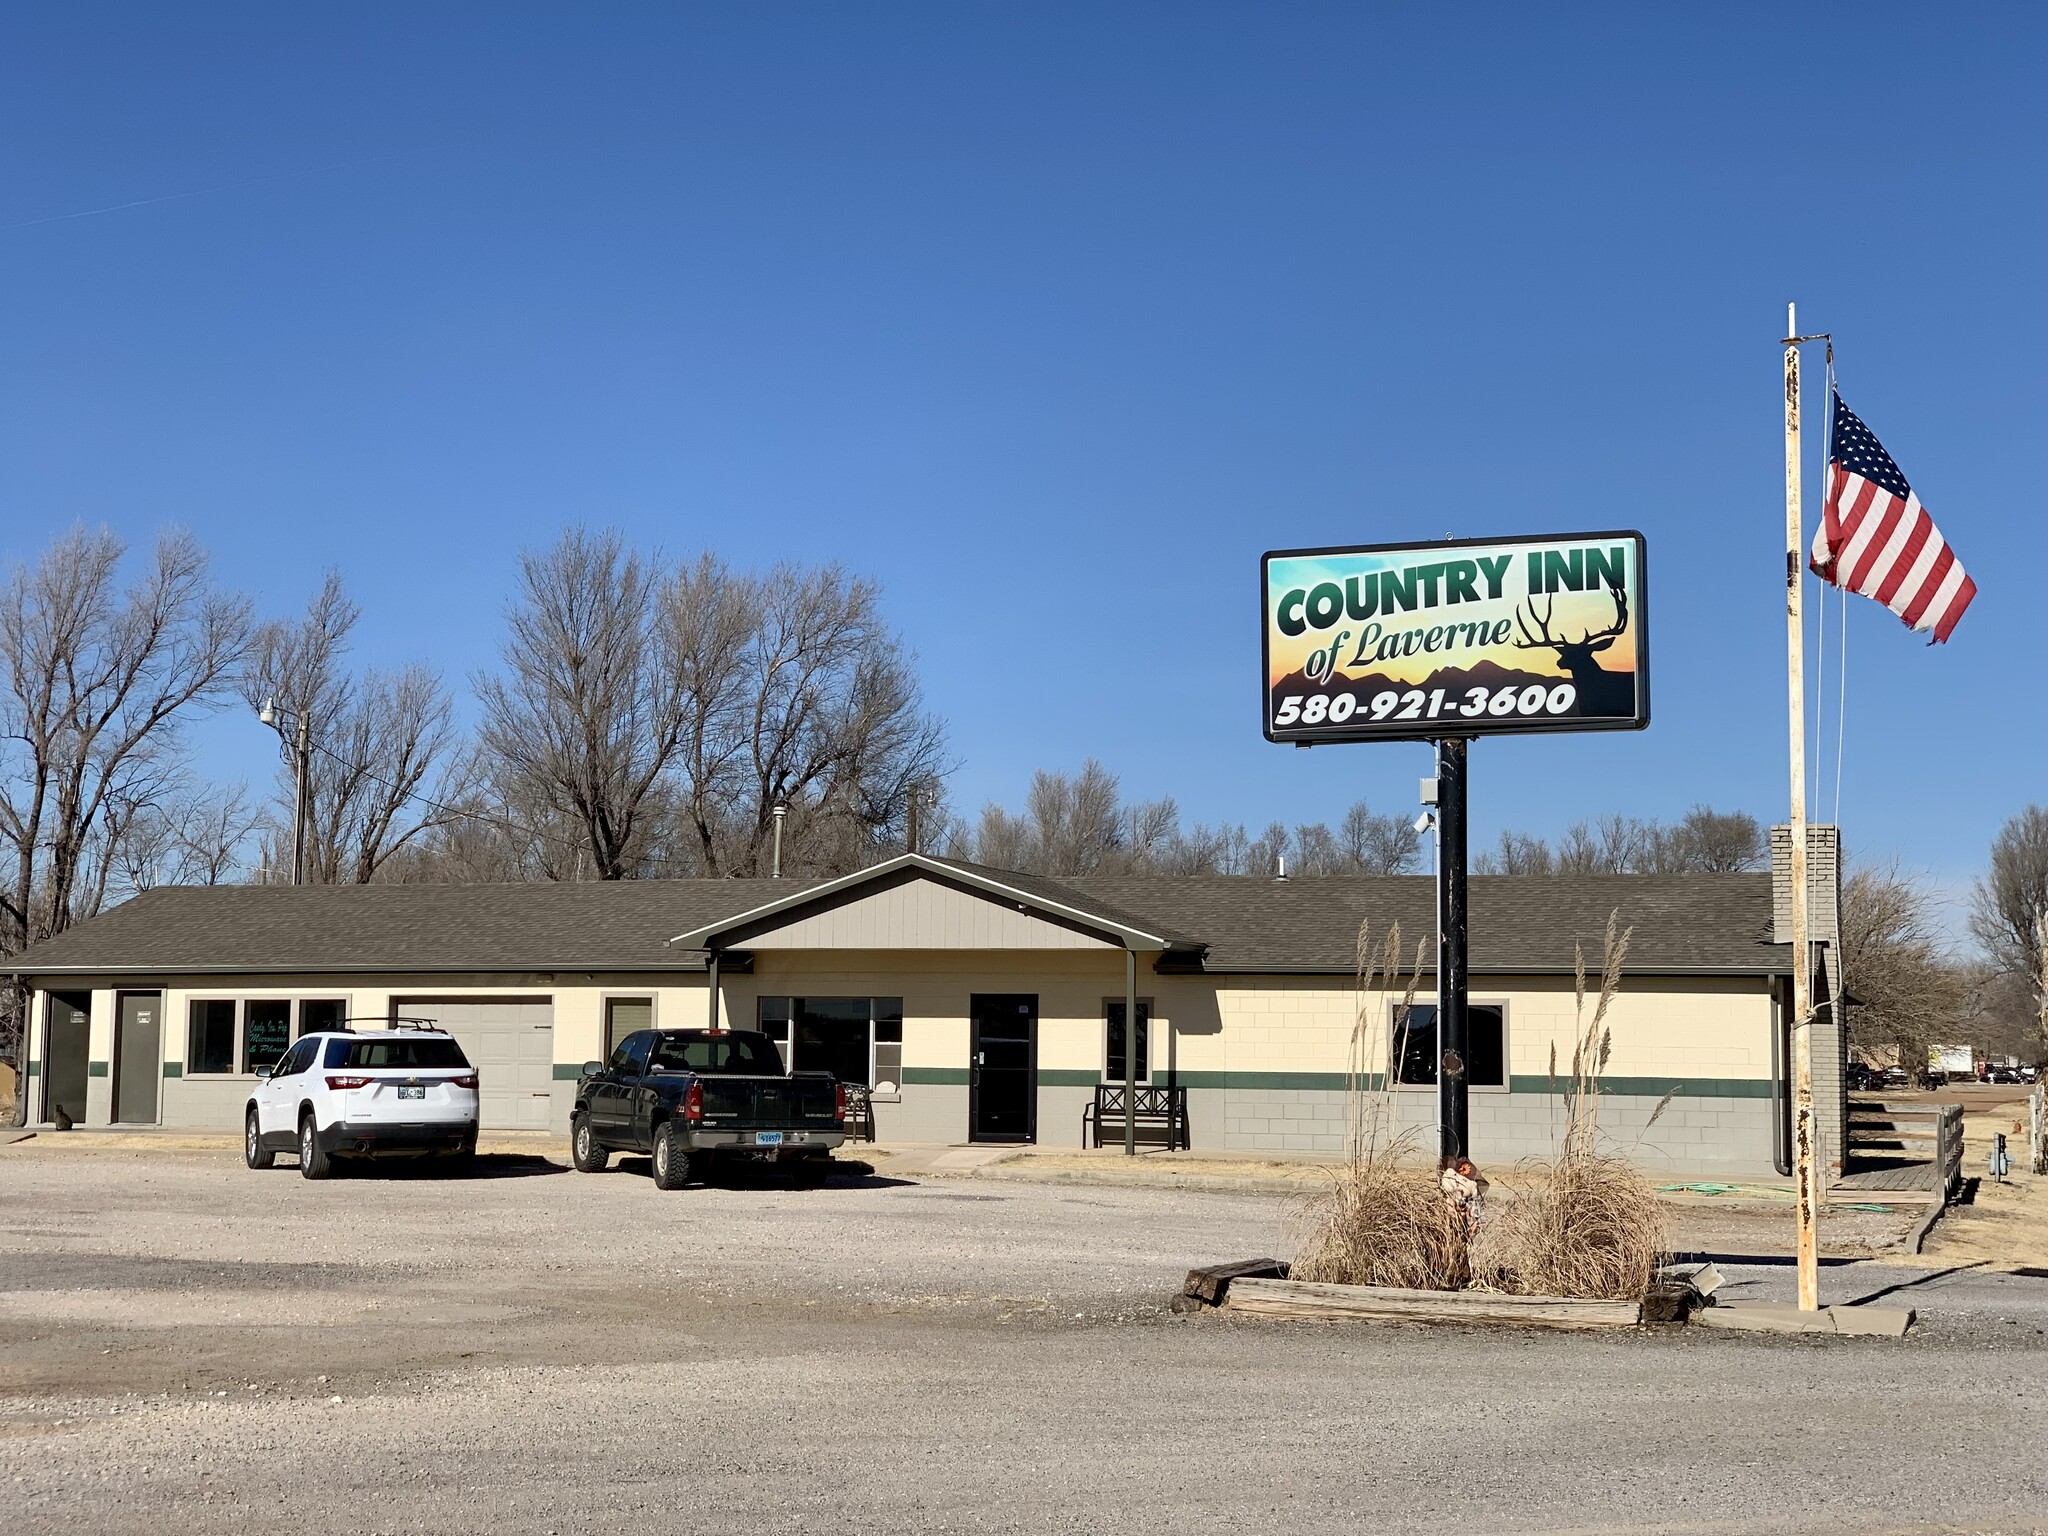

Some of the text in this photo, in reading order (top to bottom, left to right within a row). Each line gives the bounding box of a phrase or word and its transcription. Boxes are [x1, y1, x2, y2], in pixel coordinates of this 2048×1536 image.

[1277, 547, 1626, 636] COUNTRY INN
[1305, 617, 1512, 684] of Laverne
[1274, 684, 1576, 725] 580-921-3600
[249, 1033, 287, 1042] Microwave
[249, 1044, 287, 1053] & Phone
